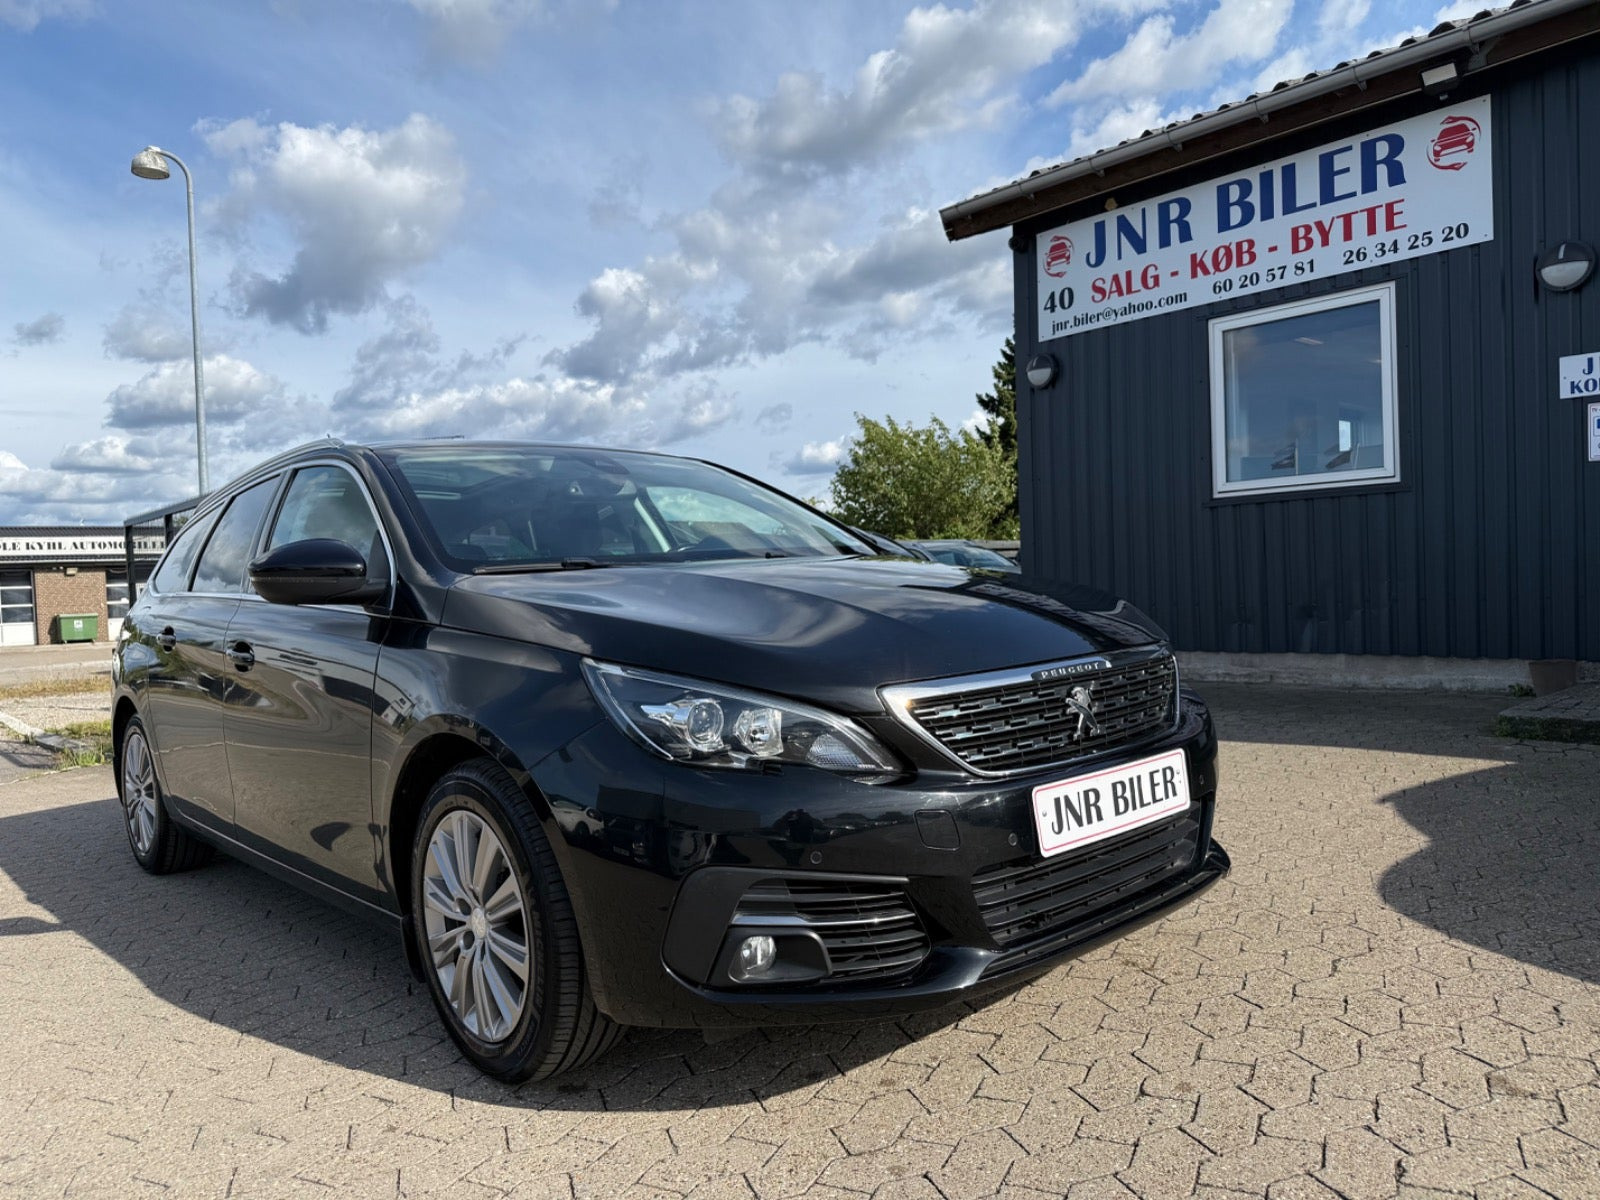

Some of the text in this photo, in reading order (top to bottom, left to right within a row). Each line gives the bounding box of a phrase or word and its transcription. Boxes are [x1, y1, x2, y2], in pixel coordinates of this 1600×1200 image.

[1085, 133, 1407, 269] JNR BILER
[1091, 198, 1407, 304] SALG - KØB - BYTTE
[1212, 222, 1470, 295] 60 20 57 81 26 34 25 20
[1043, 286, 1075, 314] 40
[1051, 291, 1188, 335] jnr.biler@yahoo.com
[1570, 378, 1600, 395] KO
[0, 541, 21, 551] LE
[25, 540, 67, 551] KYHL
[1041, 662, 1099, 679] PEUGEOT
[1051, 765, 1178, 835] JNR BILER
